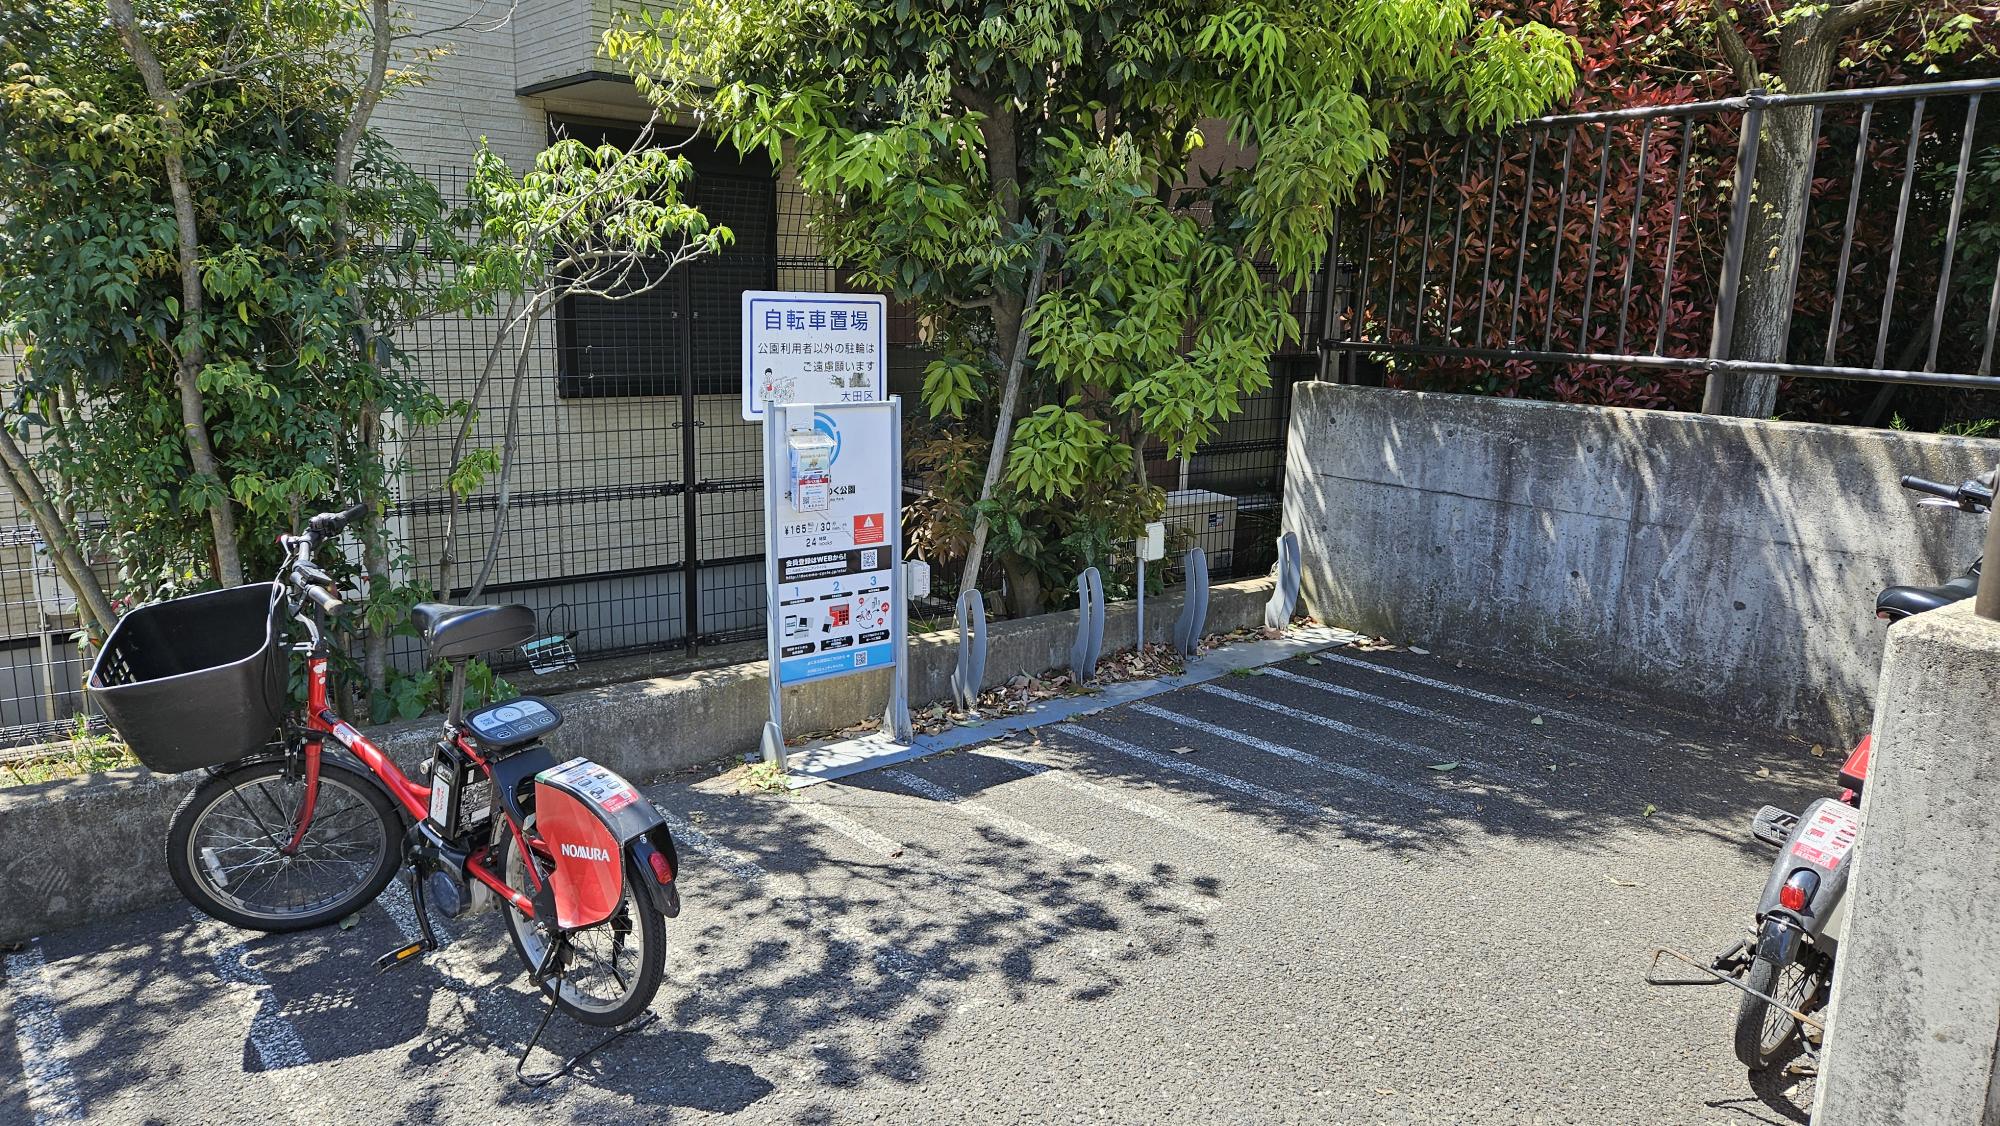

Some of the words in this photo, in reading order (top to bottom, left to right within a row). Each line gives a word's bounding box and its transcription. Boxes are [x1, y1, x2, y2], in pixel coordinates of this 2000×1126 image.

[765, 309, 868, 331] 自転車置場
[758, 342, 875, 355] 公園利用者以外の駐輪は
[803, 361, 875, 373] ご遠慮願います
[841, 390, 874, 402] 大田区
[784, 524, 807, 535] ¥165
[820, 522, 831, 532] 30
[806, 538, 817, 548] 24
[794, 587, 799, 597] 1
[833, 581, 840, 592] 2
[870, 575, 877, 586] 3
[561, 843, 611, 863] NOMURA
